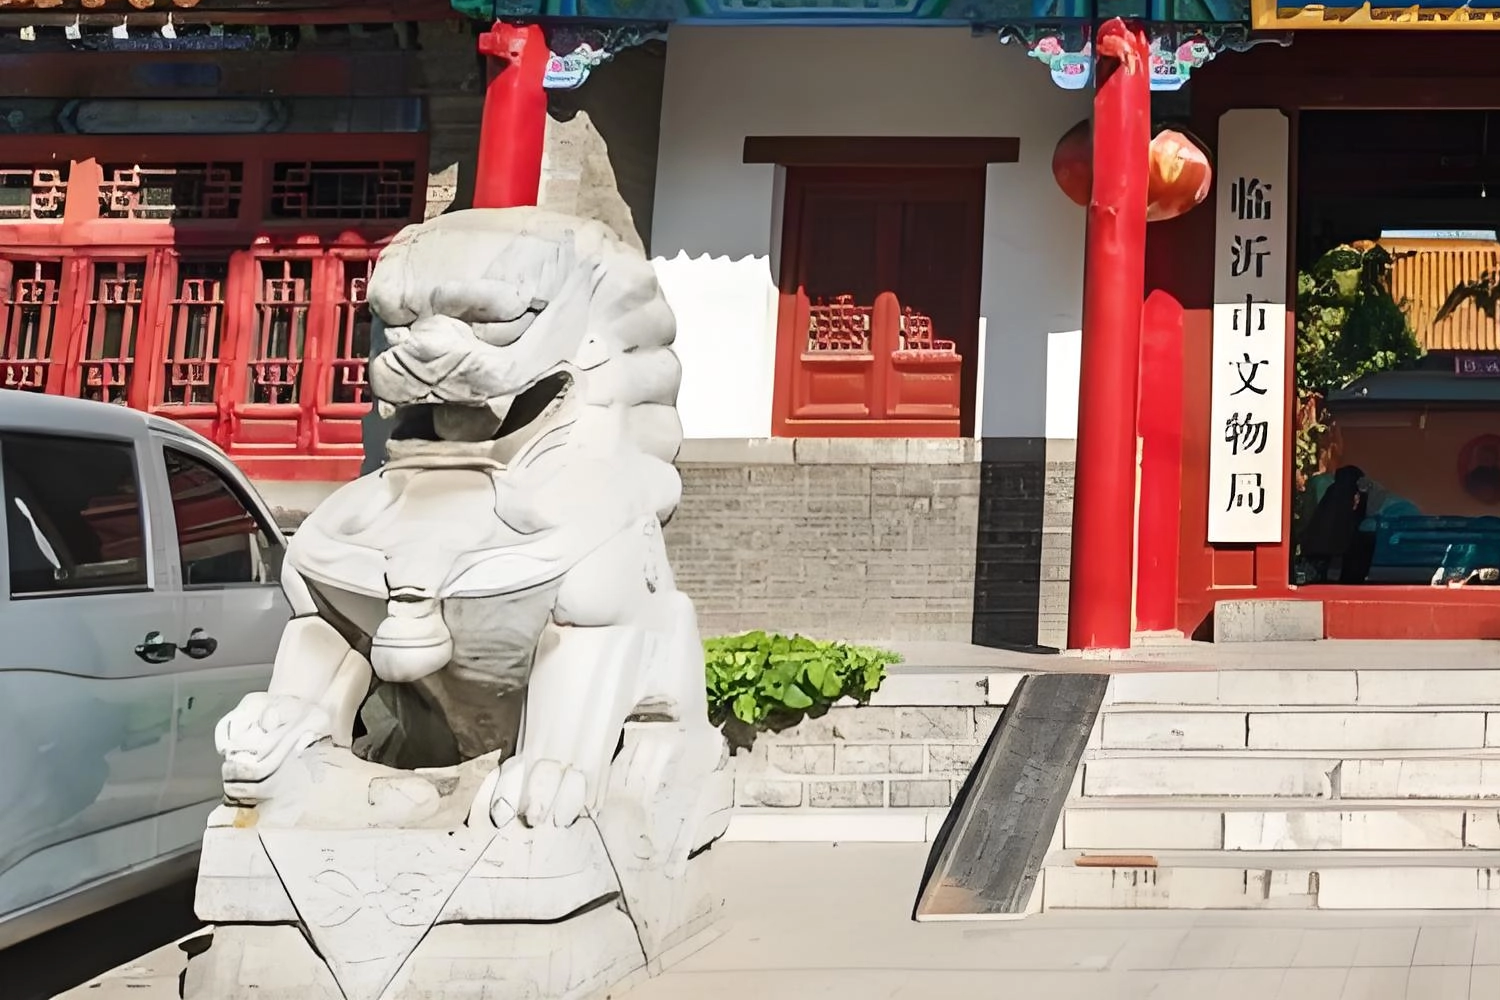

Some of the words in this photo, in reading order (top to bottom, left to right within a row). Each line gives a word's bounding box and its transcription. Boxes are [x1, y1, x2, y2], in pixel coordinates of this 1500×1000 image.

[1224, 176, 1273, 514] 临沂市文物局
